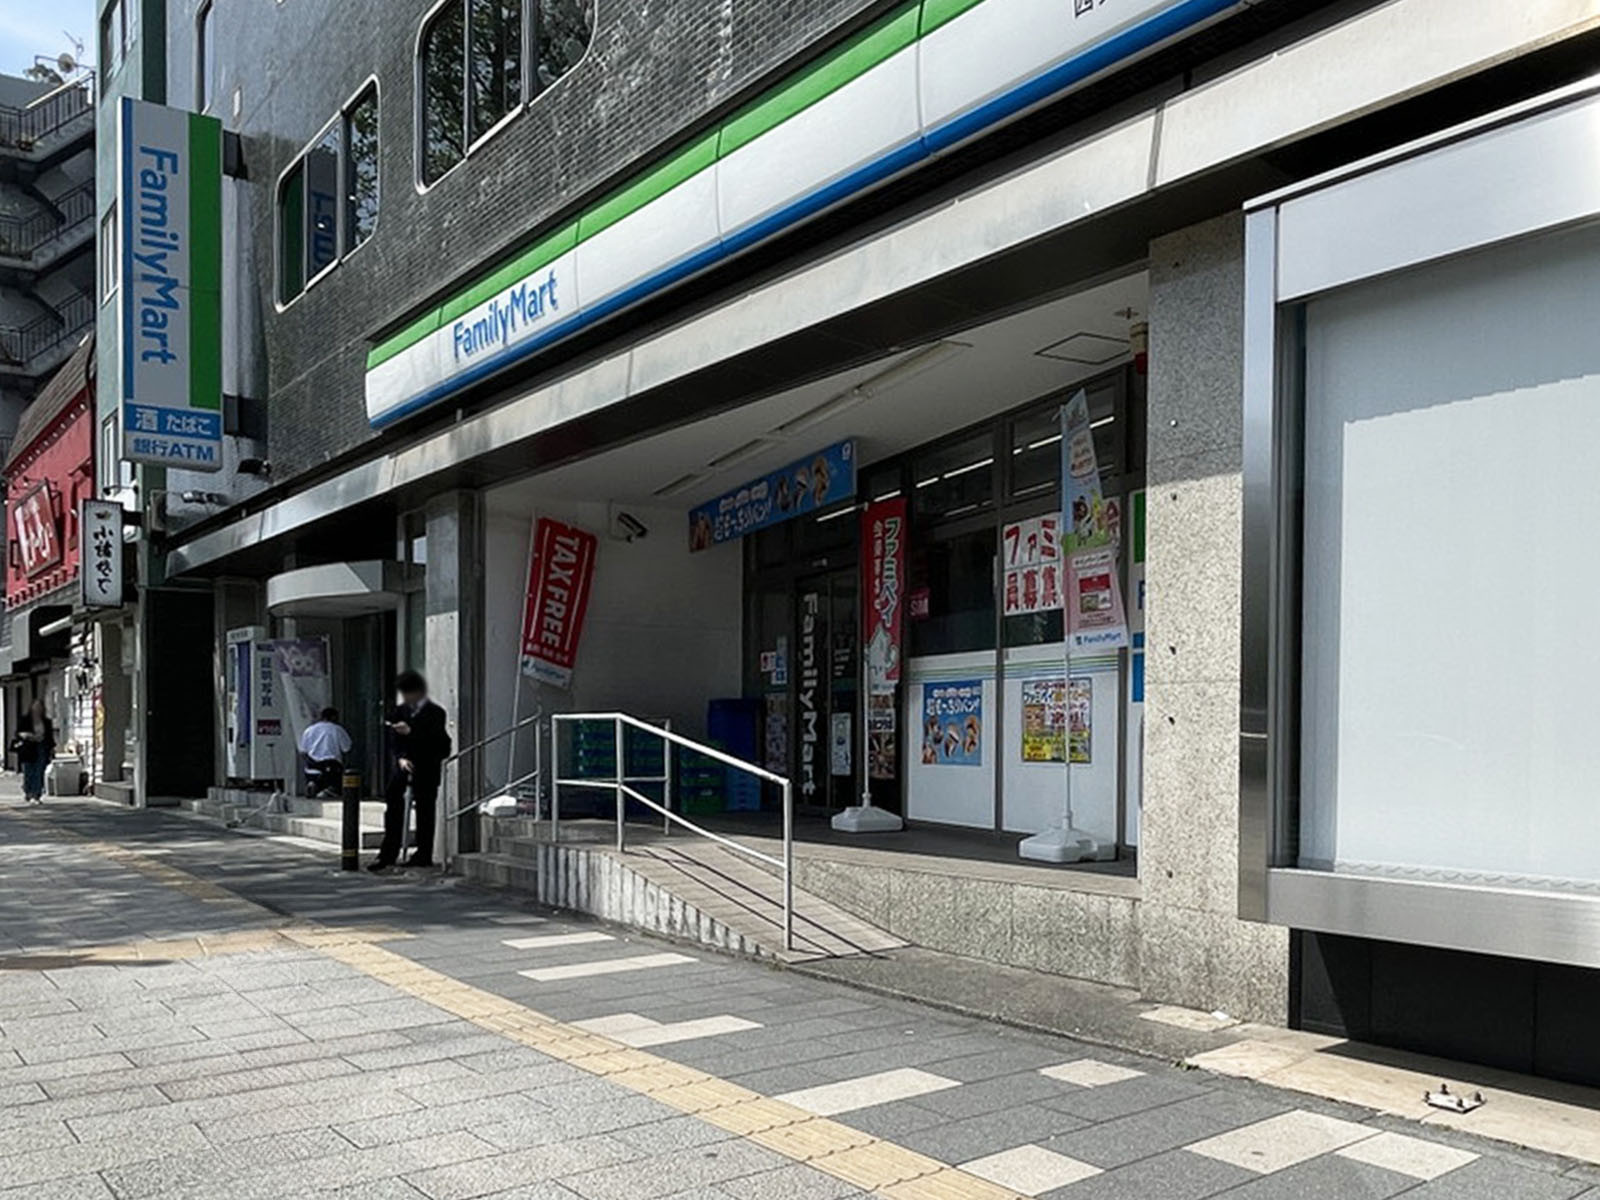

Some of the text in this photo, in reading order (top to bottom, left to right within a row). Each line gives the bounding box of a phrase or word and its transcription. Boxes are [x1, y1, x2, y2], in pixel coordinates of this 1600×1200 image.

[134, 146, 180, 365] FamilyMart
[453, 270, 558, 363] FamilyMart
[134, 438, 213, 461] 銀行ATM
[136, 408, 212, 435] 酒 たばこ
[548, 535, 580, 586] TAX
[879, 517, 902, 628] ファミペイ
[541, 585, 569, 648] FREE
[800, 592, 818, 796] FamilyMart
